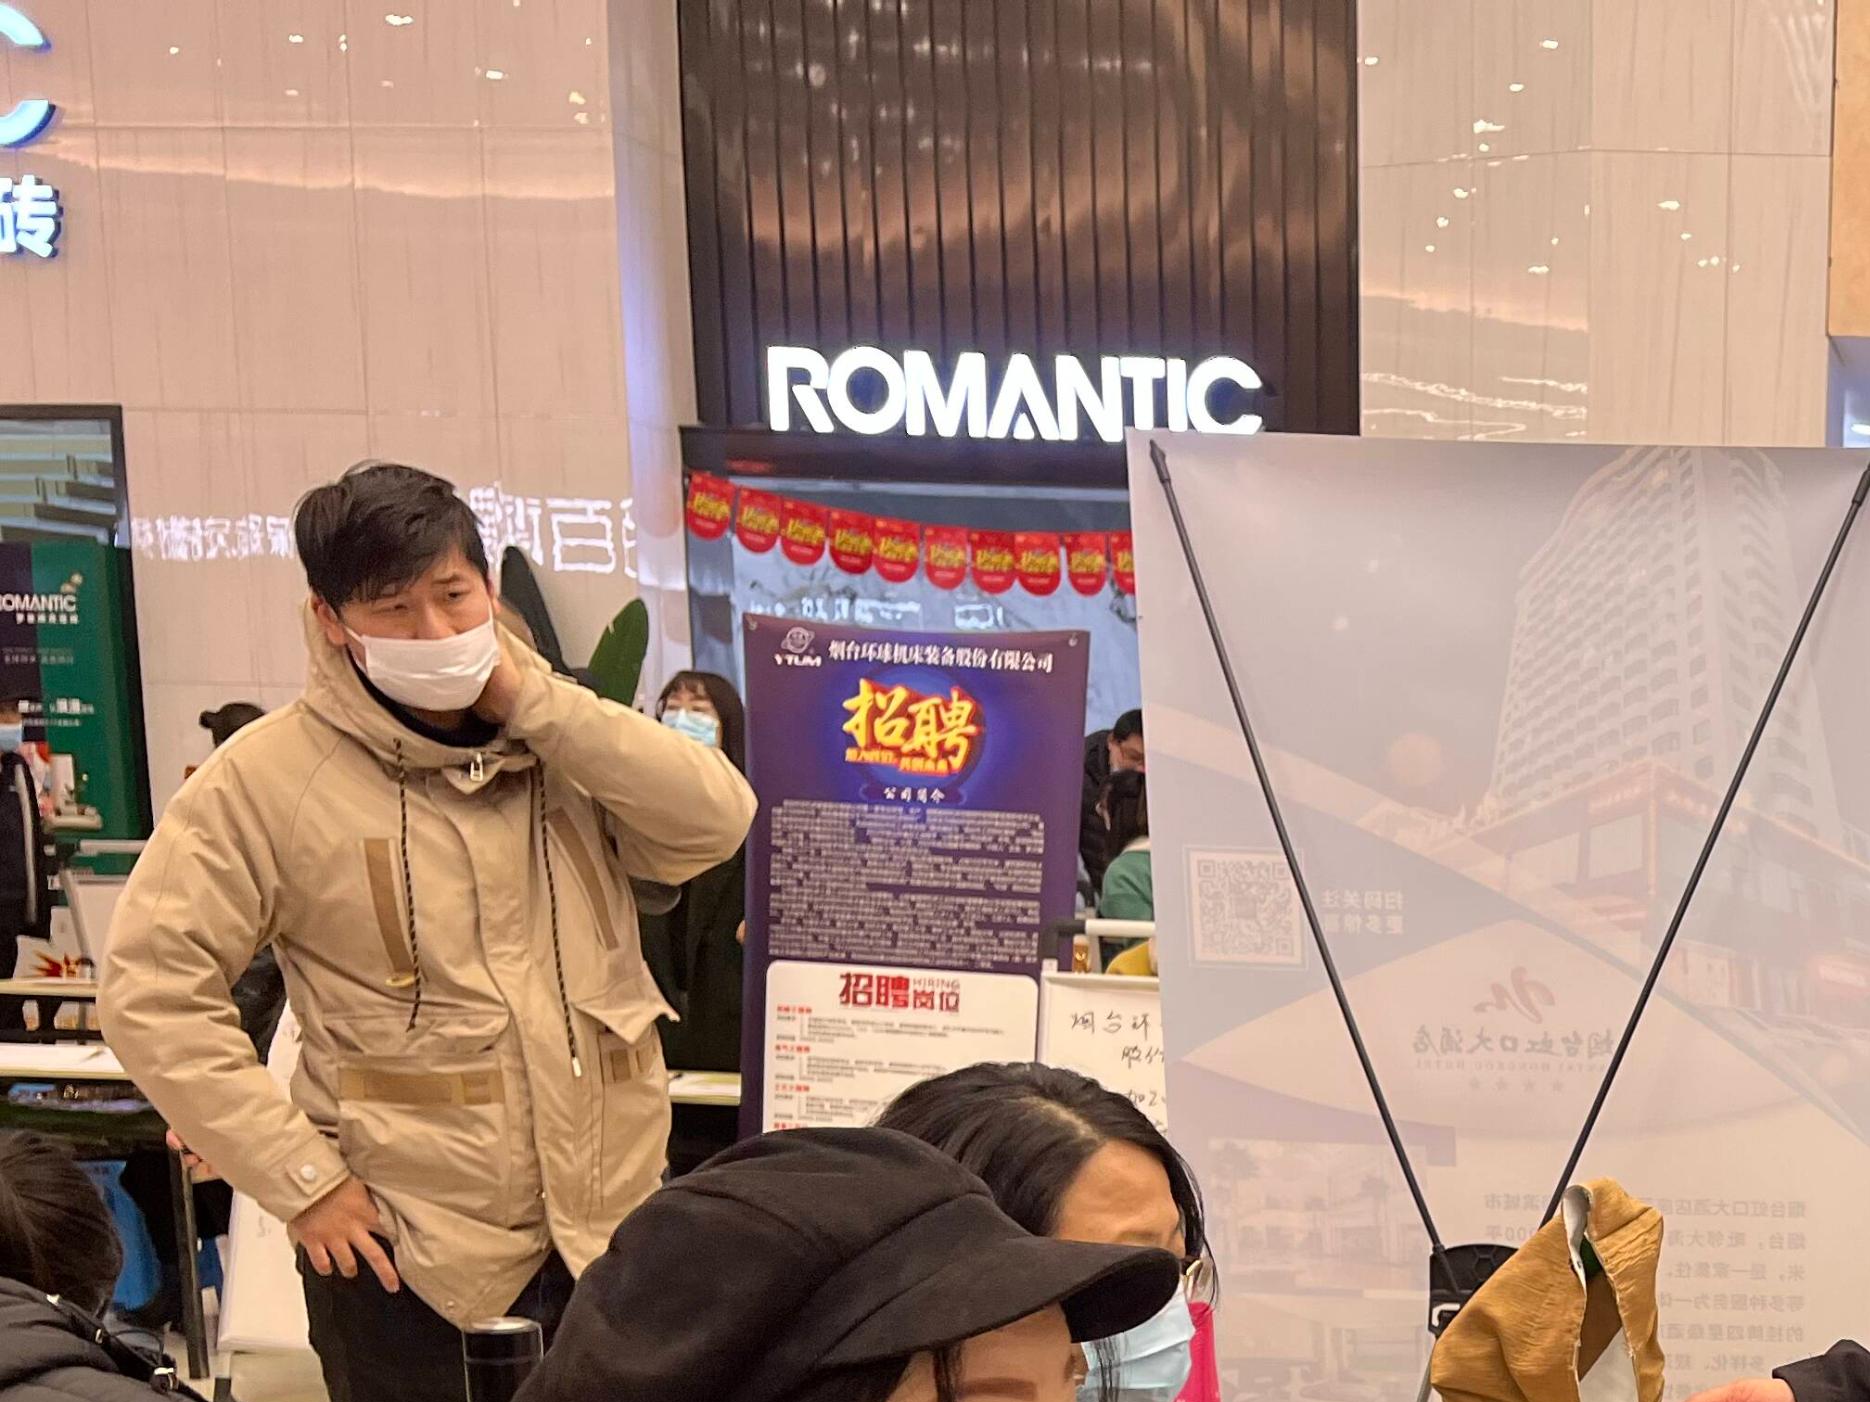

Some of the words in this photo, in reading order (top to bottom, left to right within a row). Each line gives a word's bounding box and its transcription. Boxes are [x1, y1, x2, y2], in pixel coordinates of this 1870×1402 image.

[766, 344, 1264, 444] ROMANTIC
[0, 593, 77, 613] OMANTIC
[841, 677, 979, 772] 招聘
[839, 972, 910, 1009] 招聘
[912, 990, 961, 1013] 岗位
